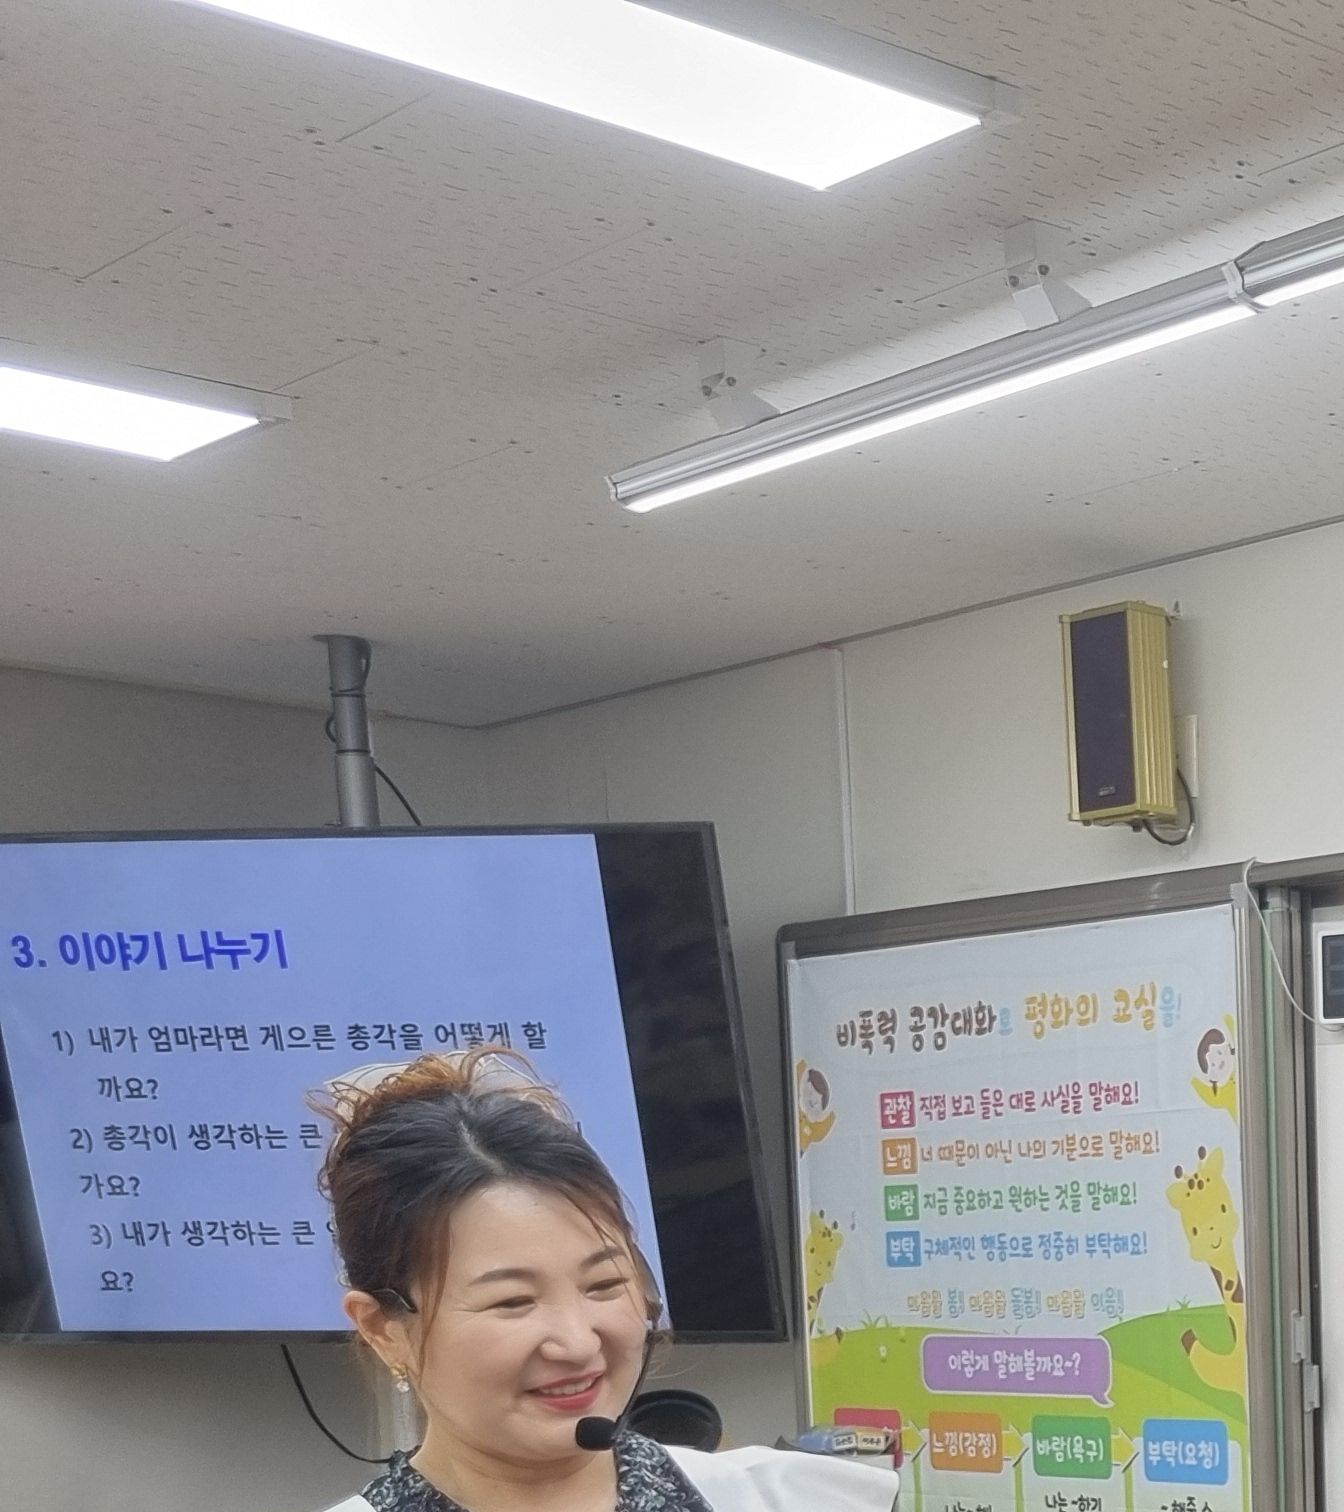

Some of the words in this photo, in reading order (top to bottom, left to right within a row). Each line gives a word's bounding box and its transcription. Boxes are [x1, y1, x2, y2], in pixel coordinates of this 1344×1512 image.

[11, 935, 47, 968] 3.
[58, 931, 167, 971] 이야기
[177, 930, 288, 970] 나누기
[52, 1030, 75, 1056] 1)
[88, 1025, 138, 1053] 내가
[148, 1025, 250, 1052] 엄마라면
[259, 1024, 336, 1052] 게으른
[347, 1024, 423, 1052] 총각을
[434, 1022, 511, 1049] 어떻게
[522, 1021, 547, 1050] 할
[835, 1008, 898, 1055] 비폭력
[908, 999, 1014, 1053] 공감대화로
[1024, 992, 1099, 1040] 평화의
[97, 1076, 159, 1101] 까요?
[884, 1093, 915, 1127] 관찰
[919, 1095, 946, 1121] 직접
[952, 1095, 975, 1117] 보고
[980, 1088, 1004, 1120] 들은
[1009, 1090, 1037, 1114] 대로
[1041, 1081, 1083, 1115] 사실을
[1089, 1081, 1139, 1111] 말해요!
[69, 1128, 92, 1153] 2)
[104, 1124, 178, 1151] 총각이
[188, 1123, 288, 1151] 생각하는
[299, 1124, 323, 1149] 큰
[886, 1144, 915, 1171] 느낌
[938, 1139, 980, 1167] 때문이
[985, 1139, 1012, 1164] 아닌
[1017, 1139, 1046, 1159] 나의
[1051, 1133, 1104, 1162] 기분으로
[1109, 1130, 1160, 1160] 말해요!
[80, 1174, 140, 1199] 가요?
[923, 1187, 948, 1215] 지금
[953, 1185, 1004, 1215] 중요하고
[1008, 1184, 1050, 1213] 원하는
[1054, 1180, 1082, 1213] 것을
[1086, 1181, 1137, 1212] 말해요!
[90, 1224, 112, 1249] 3)
[121, 1222, 171, 1247] 내가
[181, 1221, 281, 1247] 생각하는
[292, 1221, 315, 1246] 큰
[924, 1236, 975, 1261] 구체적인
[980, 1233, 1033, 1262] 행동으로
[1038, 1231, 1079, 1262] 정중히
[1085, 1231, 1148, 1259] 부탁해요!
[100, 1271, 134, 1293] 요?
[948, 1350, 990, 1378] 이렇게
[932, 1430, 997, 1460] 느낌(감정)
[1036, 1435, 1104, 1466] 바람(욕구)
[1148, 1439, 1220, 1470] 부탁(요청)
[1044, 1491, 1069, 1512] 나는
